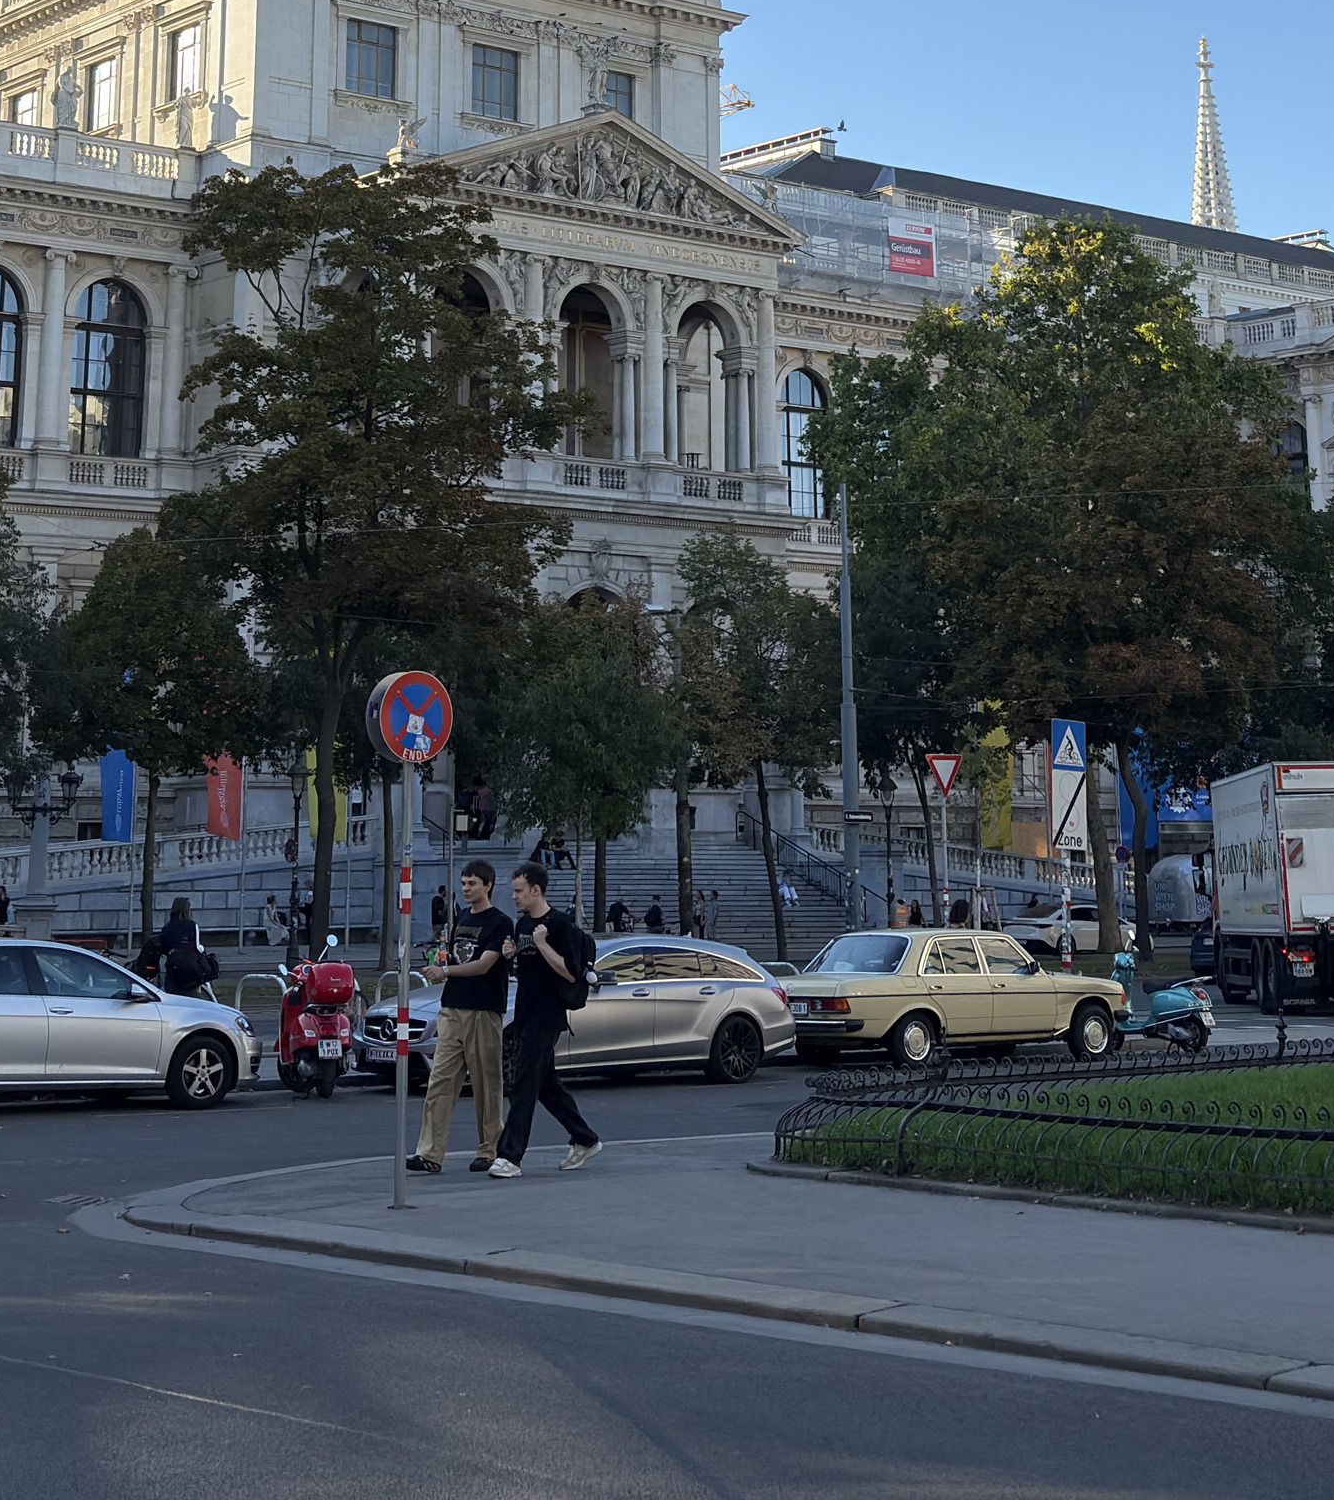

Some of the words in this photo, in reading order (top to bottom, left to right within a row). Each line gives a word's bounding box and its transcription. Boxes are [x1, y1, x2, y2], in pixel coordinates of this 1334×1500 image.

[542, 225, 635, 251] LITTERARVM
[646, 242, 761, 272] VINDOBONENSIS
[891, 243, 922, 255] Gerüstbau
[1058, 832, 1083, 848] Zone
[1154, 902, 1176, 912] SHOP
[1283, 998, 1316, 1006] SCANIA
